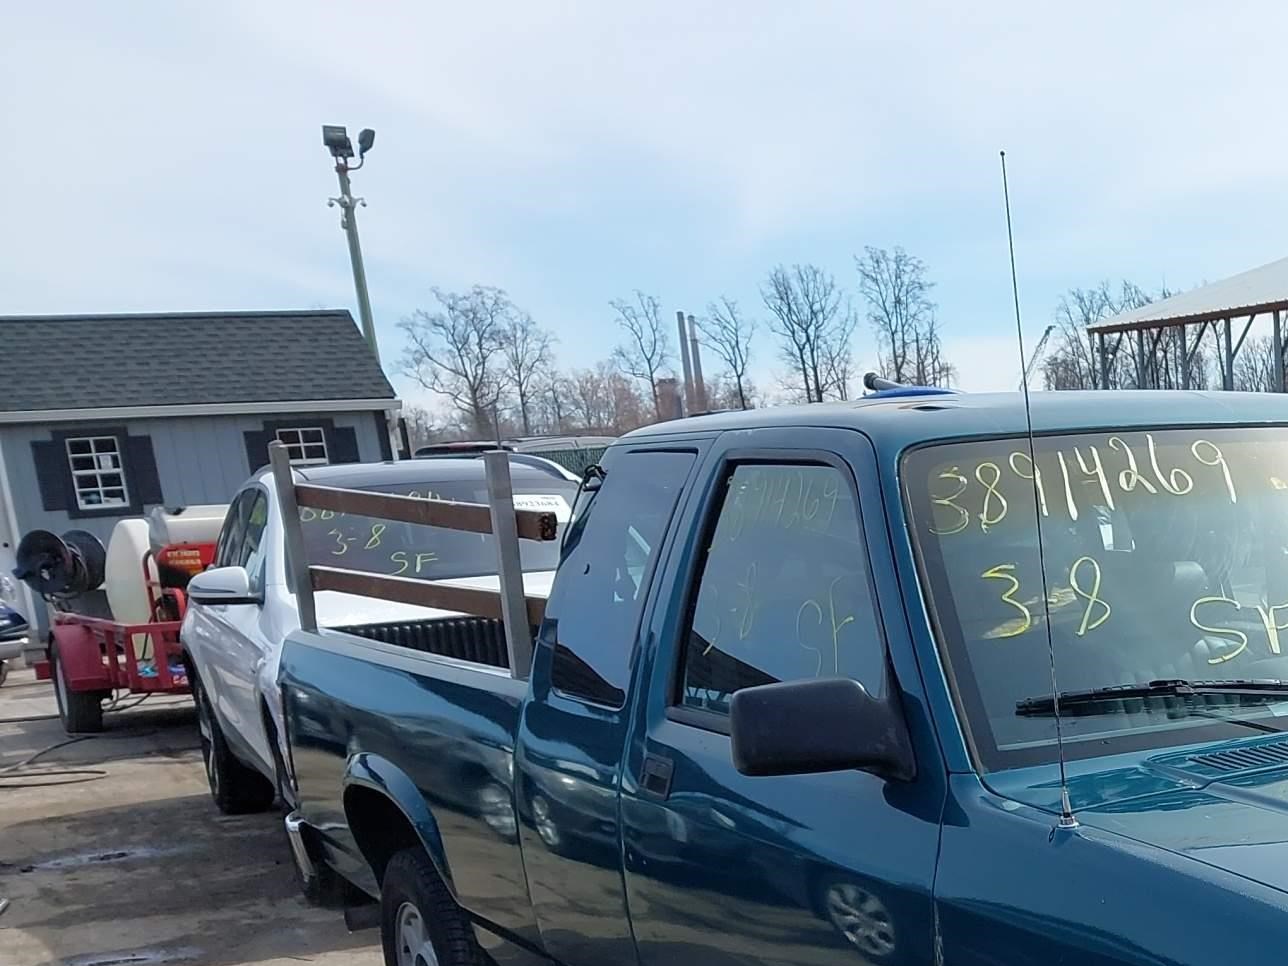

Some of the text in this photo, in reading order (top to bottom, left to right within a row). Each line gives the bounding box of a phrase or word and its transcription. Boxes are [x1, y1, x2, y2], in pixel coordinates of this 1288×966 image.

[929, 434, 1237, 534] 38914269
[328, 523, 386, 556] 3-8
[388, 551, 439, 576] SF
[981, 556, 1111, 640] 3-8
